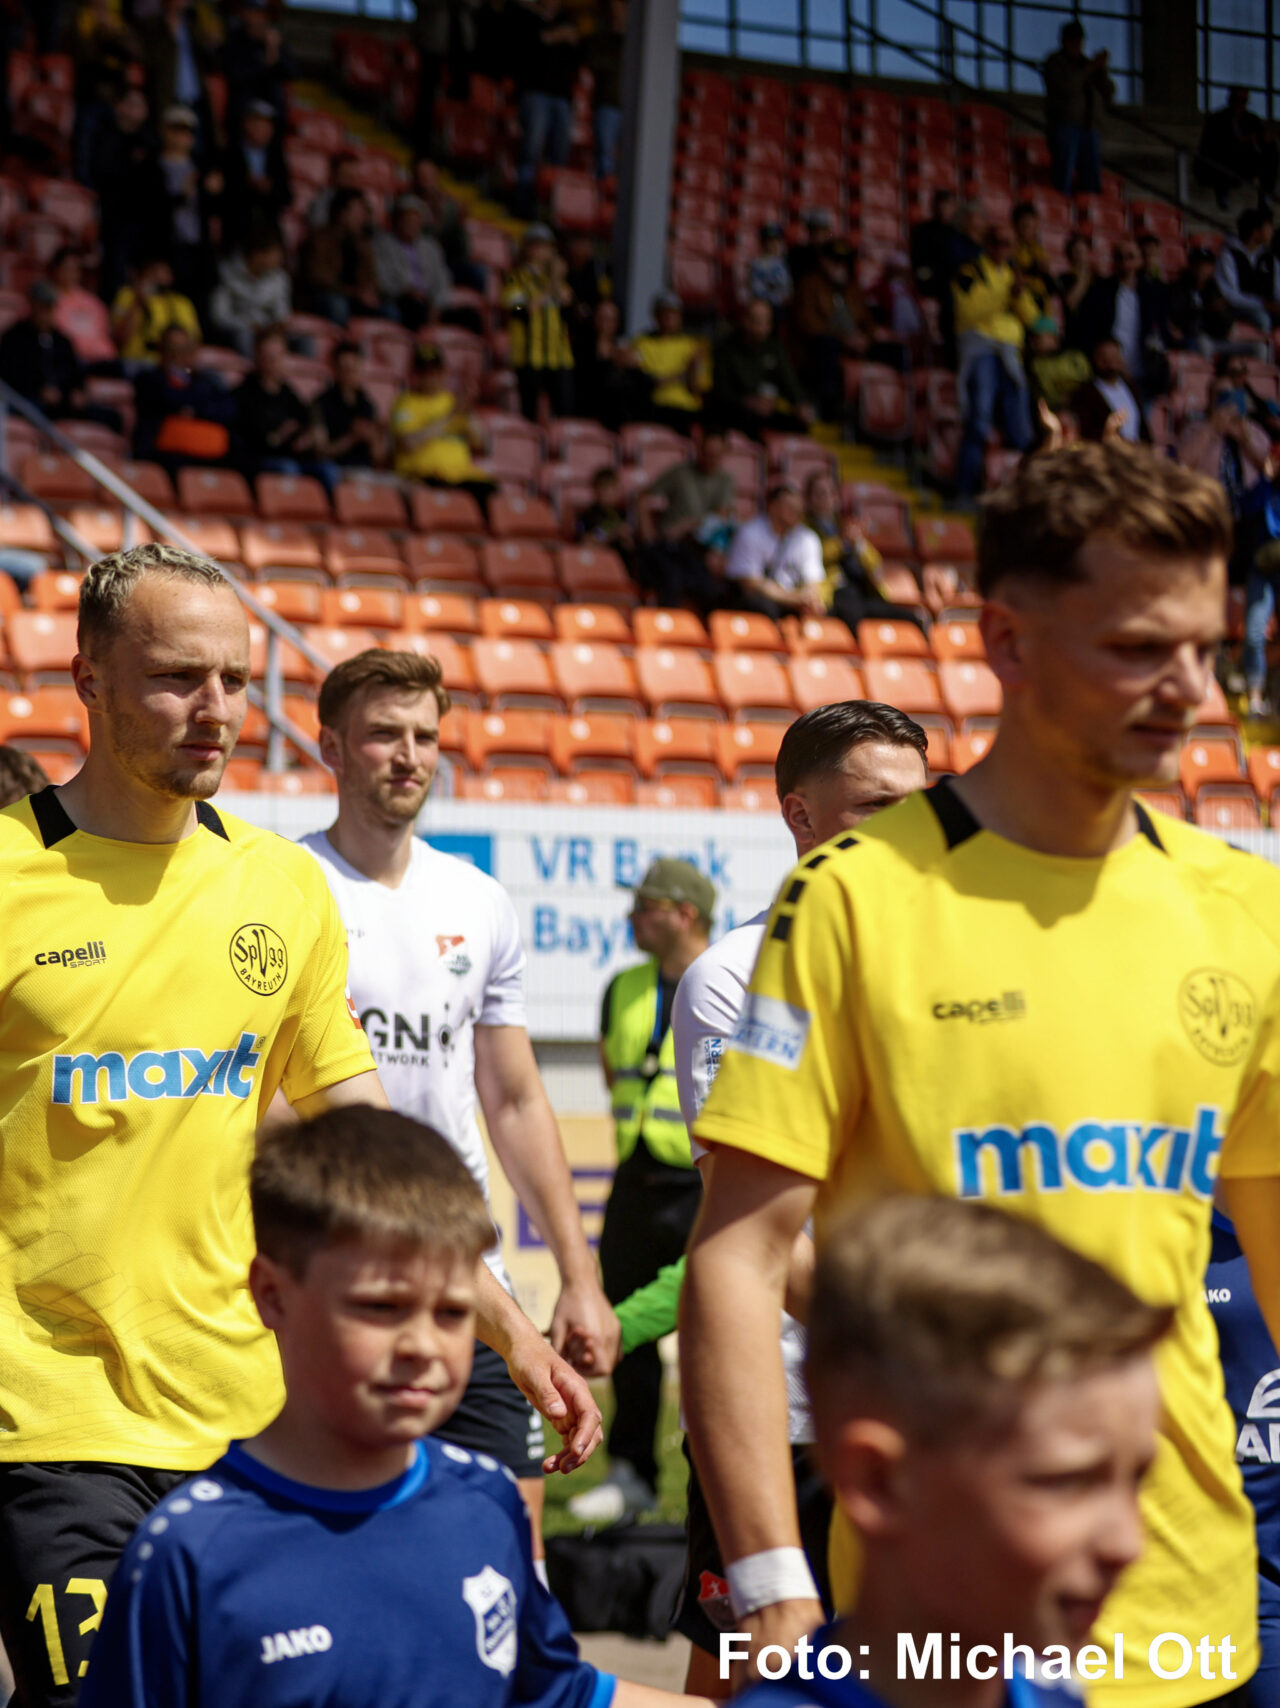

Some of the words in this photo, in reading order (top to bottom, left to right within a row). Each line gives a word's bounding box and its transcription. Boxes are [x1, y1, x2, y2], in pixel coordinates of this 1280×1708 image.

[530, 835, 595, 882] VR
[34, 940, 107, 968] capelli
[69, 957, 107, 969] SPORT
[239, 967, 283, 992] BAYREUTH
[51, 1030, 262, 1105] maxit
[952, 1104, 1224, 1201] maxit
[260, 1625, 333, 1664] JAKO
